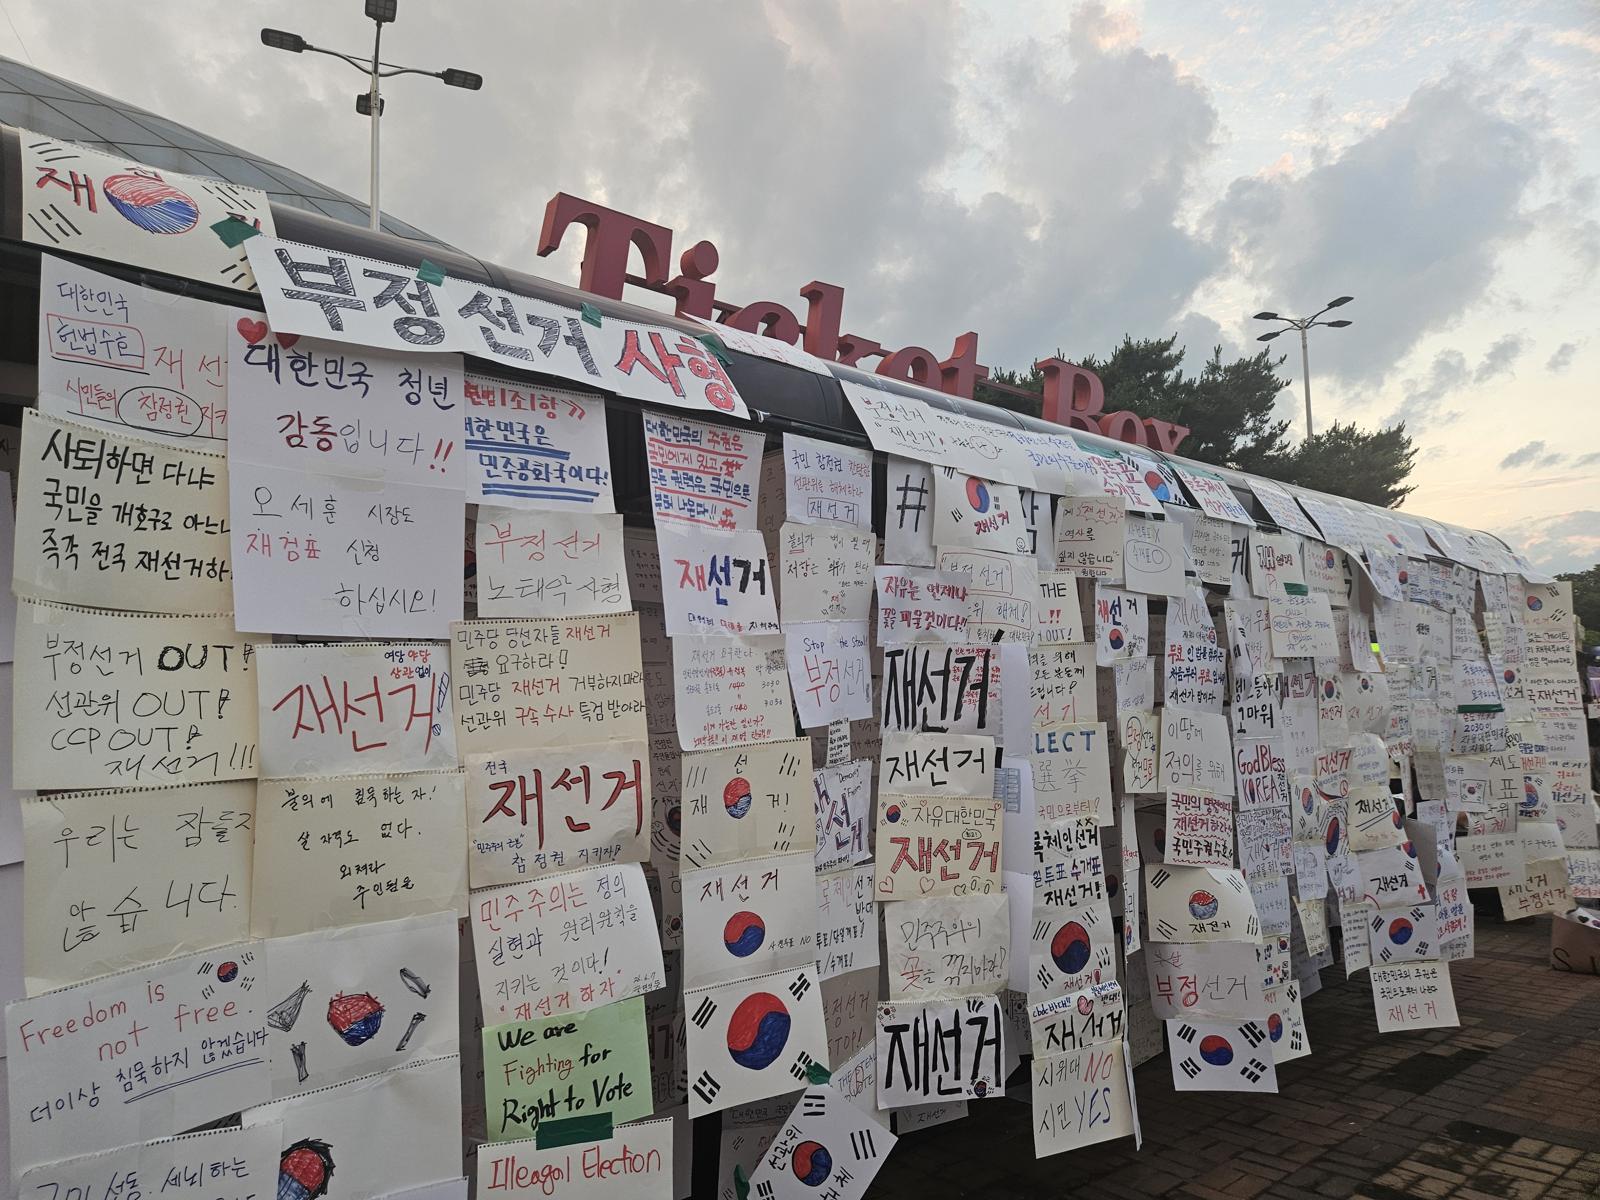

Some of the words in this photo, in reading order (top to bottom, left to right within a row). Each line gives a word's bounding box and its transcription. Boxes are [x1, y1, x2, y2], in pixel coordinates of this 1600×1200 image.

[57, 282, 129, 323] 대한민국
[274, 248, 604, 378] 부정선거
[614, 329, 736, 413] 사형
[243, 342, 374, 399] 대한민국
[398, 367, 456, 411] 청년
[137, 391, 193, 425] 참정권
[861, 396, 926, 424] 부정선거
[276, 410, 454, 473] 감동입니다!!
[708, 430, 743, 451] 주권은
[41, 429, 154, 485] 사퇴하면
[163, 461, 216, 490] 다냐
[480, 453, 609, 487] 민주공화국이다!
[792, 450, 811, 471] 국민
[43, 478, 103, 526] 국민을
[112, 502, 173, 532] 개호구로
[367, 503, 416, 526] 시장도
[809, 500, 855, 524] 재선거
[974, 510, 1010, 536] 재선거
[42, 528, 79, 570] 즉각
[92, 541, 126, 573] 전국
[245, 527, 322, 562] 재검표
[346, 538, 380, 566] 신청
[485, 523, 600, 563] 부정선거
[788, 532, 815, 550] 불의가
[488, 573, 571, 606] 노태악
[577, 573, 622, 603] 사형
[674, 555, 766, 606] 재선거
[882, 575, 922, 602] 자유는
[926, 582, 969, 603] 언제나
[1040, 582, 1068, 599] THE
[334, 582, 436, 616] 하십시오!
[1097, 595, 1138, 626] 재선거
[458, 628, 499, 650] 민주당
[506, 625, 560, 650] 당선자들
[566, 623, 611, 642] 재선거
[804, 637, 825, 654] Stop
[43, 633, 143, 681] 부정선거
[384, 650, 406, 664] 여당
[408, 649, 431, 663] 야당
[390, 666, 414, 679] 상관
[415, 664, 432, 679] 없이
[496, 649, 569, 675] 요구하라!
[459, 681, 501, 706] 민주당
[512, 676, 560, 696] 재선거
[804, 655, 866, 708] 부정선거
[885, 645, 991, 734] 재선거
[45, 689, 119, 724] 선관위
[461, 709, 506, 733] 선관위
[515, 705, 539, 727] 구속
[543, 703, 575, 724] 수사
[579, 701, 604, 723] 특검
[608, 698, 646, 718] 받아라
[1237, 703, 1274, 734] 고마워
[51, 727, 101, 755] CCP
[485, 759, 507, 776] 전국
[734, 753, 748, 775] 선
[886, 746, 985, 788] 재선거
[1165, 751, 1204, 784] 정의를
[1207, 761, 1225, 782] 위해
[1238, 749, 1259, 776] God
[1260, 745, 1286, 773] Bless
[1319, 751, 1350, 776] 재선거
[282, 789, 334, 812] 불의에
[482, 760, 643, 850] 재선거
[1172, 793, 1201, 812] 국민의
[1356, 799, 1390, 815] 재선거
[912, 804, 997, 832] 자유대한민국
[50, 812, 140, 869] 우리는
[297, 831, 311, 851] 살
[320, 829, 359, 849] 자격도
[340, 860, 385, 880] 외쳐라
[511, 849, 565, 875] 참정권
[890, 836, 1000, 882] 재선거
[1071, 855, 1102, 882] 수개표
[353, 876, 414, 909] 주인됨을
[481, 882, 587, 931] 민주주의는
[596, 871, 626, 900] 정의
[700, 869, 779, 903] 재선거
[1371, 873, 1409, 896] 재선거
[488, 927, 543, 967] 실현과
[560, 903, 639, 944] 원리원칙을
[1189, 919, 1231, 934] 재선거
[495, 974, 541, 1001] 지키는
[1156, 974, 1248, 1008] 부정선거
[1373, 968, 1412, 984] 대한민국의
[1415, 967, 1439, 981] 주권은
[20, 1001, 127, 1052] Freedom
[147, 981, 165, 1004] is
[514, 992, 570, 1022] 재선거
[580, 978, 614, 1002] 하자
[1388, 1000, 1438, 1023] 재선거
[99, 1021, 149, 1061] not
[498, 1028, 537, 1052] We
[543, 1022, 578, 1041] are
[883, 1003, 1002, 1098] 재선거
[503, 1053, 575, 1087] Fighting
[579, 1043, 612, 1067] for
[1039, 1055, 1081, 1088] 시위대
[1084, 1051, 1114, 1085] NO
[30, 1082, 100, 1123] 더이상
[116, 1047, 189, 1093] 침묵하지
[501, 1088, 560, 1133] Right
[564, 1084, 585, 1111] to
[592, 1072, 633, 1108] Vote
[1039, 1100, 1072, 1139] 시민
[1074, 1087, 1112, 1134] YES
[582, 1145, 661, 1180] Election
[769, 1124, 804, 1171] 선관위
